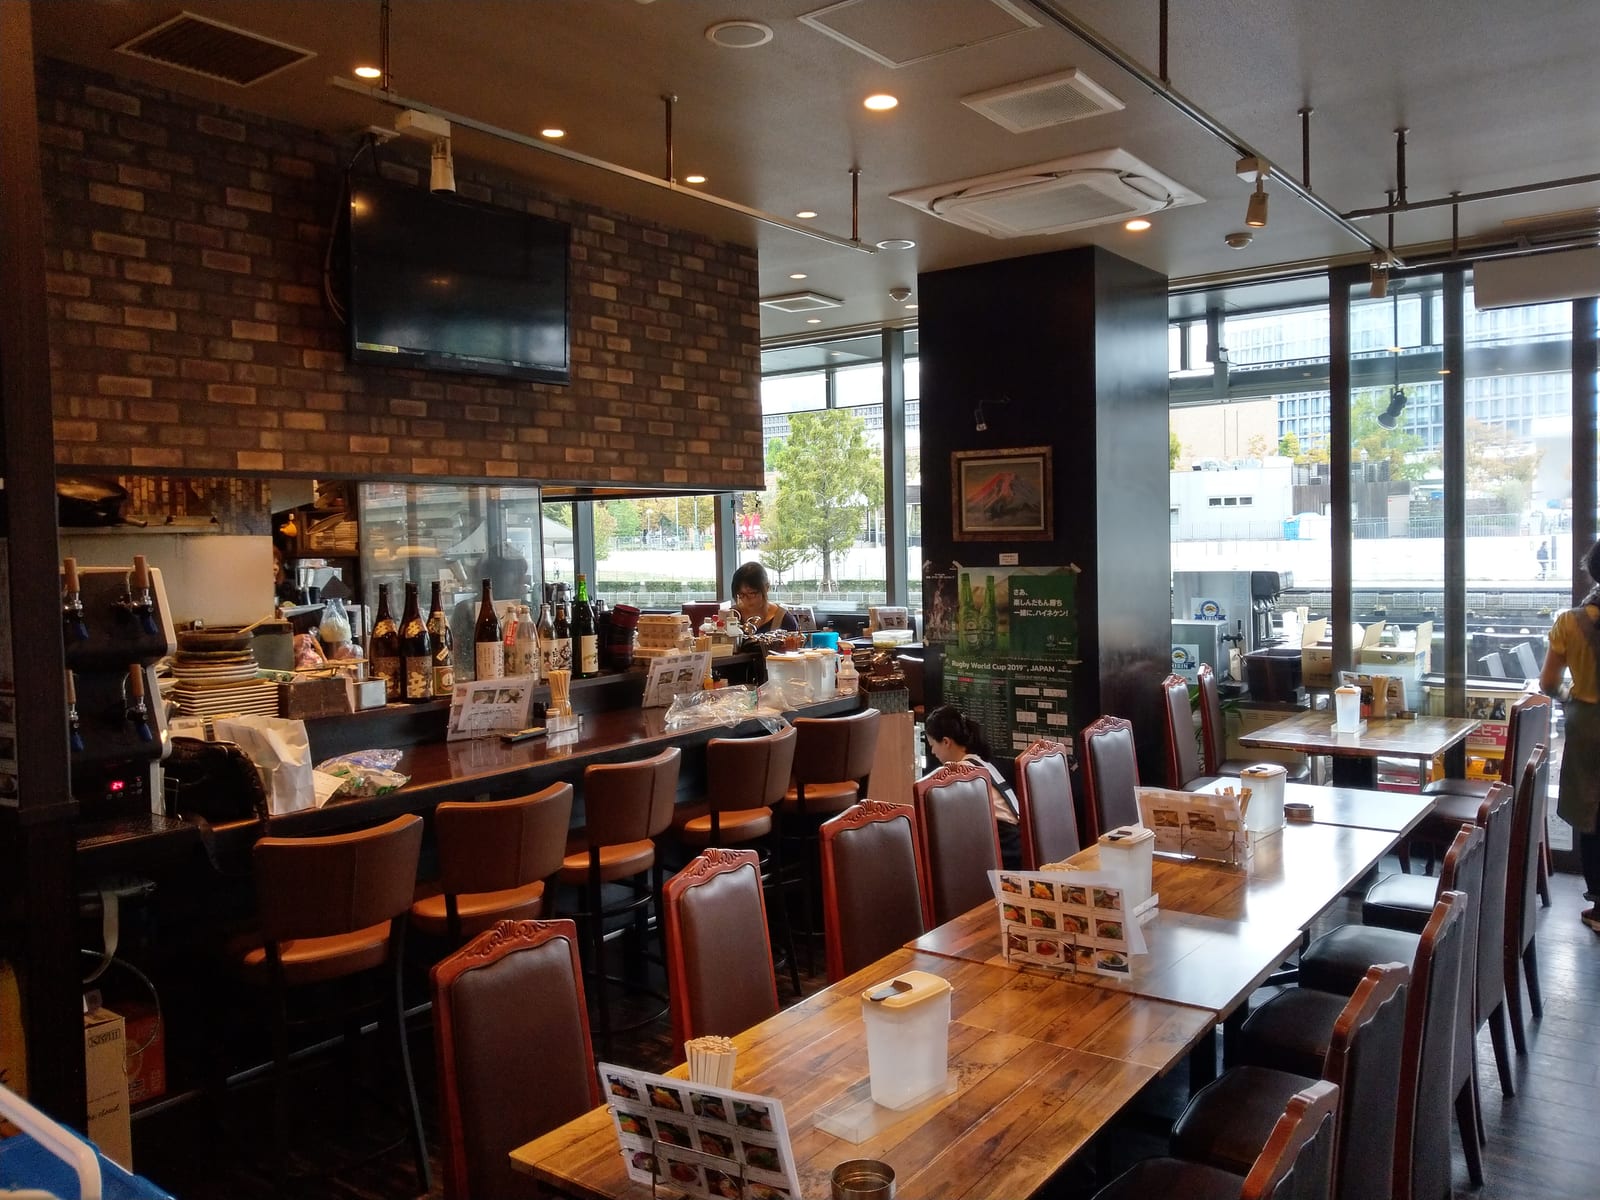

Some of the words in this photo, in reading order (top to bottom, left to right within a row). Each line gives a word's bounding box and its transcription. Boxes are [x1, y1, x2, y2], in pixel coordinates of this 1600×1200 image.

[1013, 588, 1028, 596] さあ、
[1013, 599, 1063, 607] 楽しんだもん勝ち
[951, 660, 970, 670] Rugby
[970, 661, 991, 670] World
[992, 663, 1007, 672] Cup
[1030, 665, 1055, 673] JAPAN
